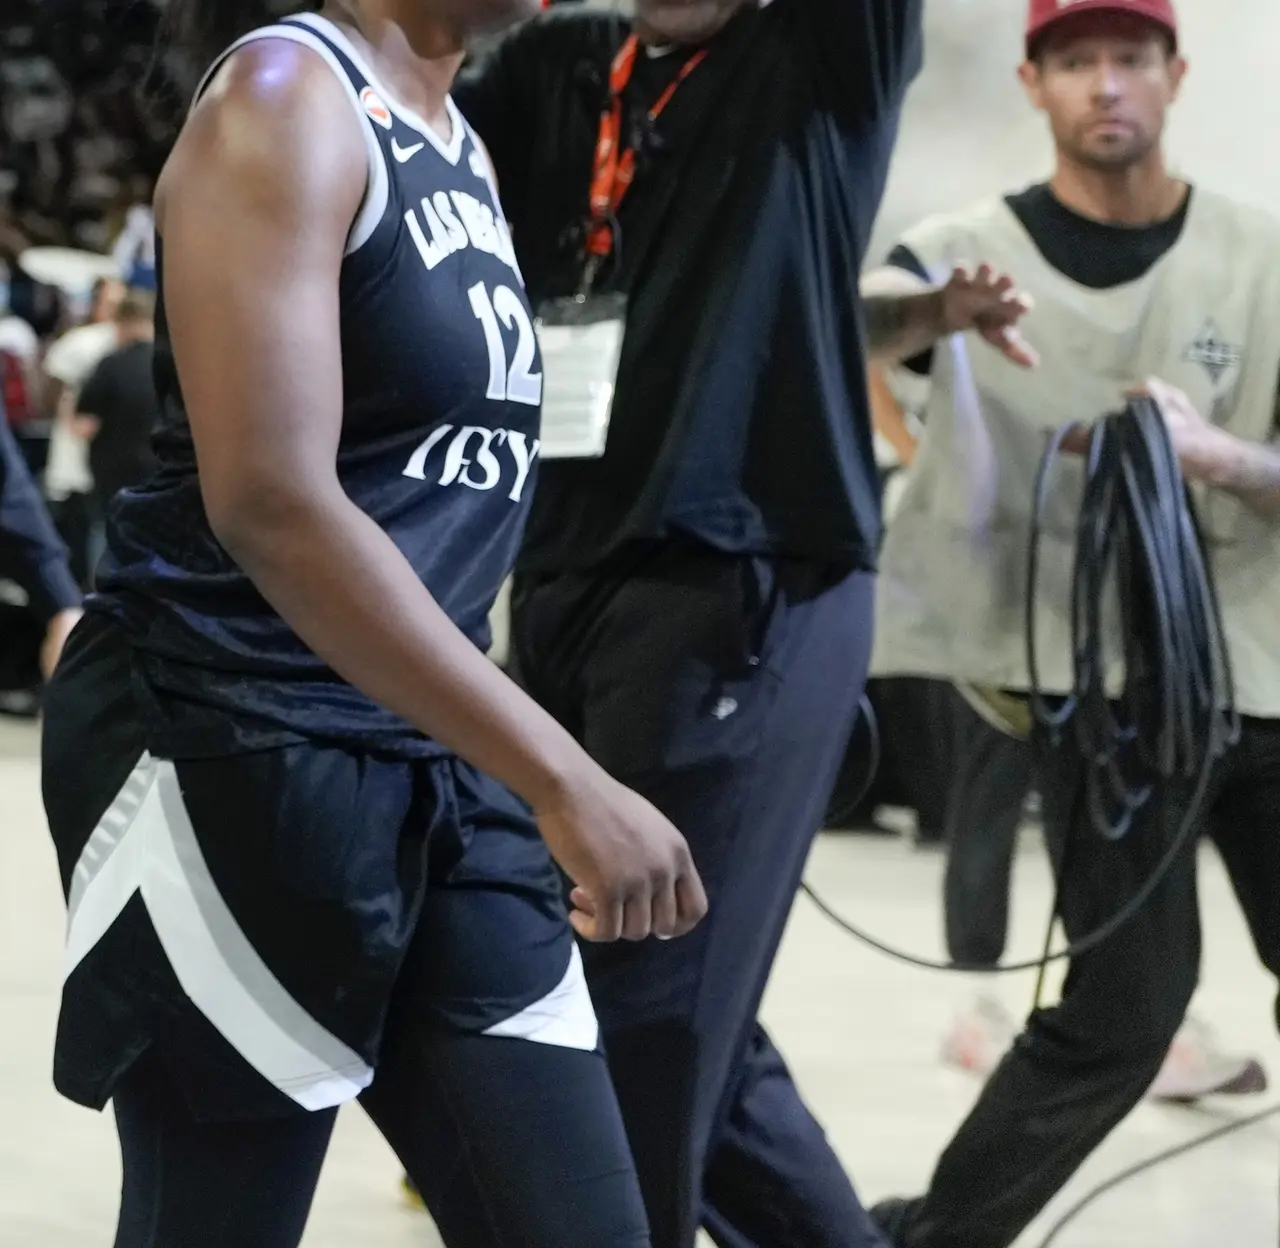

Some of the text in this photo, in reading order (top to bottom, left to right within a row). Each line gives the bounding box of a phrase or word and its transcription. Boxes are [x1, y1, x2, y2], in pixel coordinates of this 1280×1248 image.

[404, 190, 469, 270] LAS
[467, 280, 543, 406] 12
[402, 423, 541, 503] IPSY
